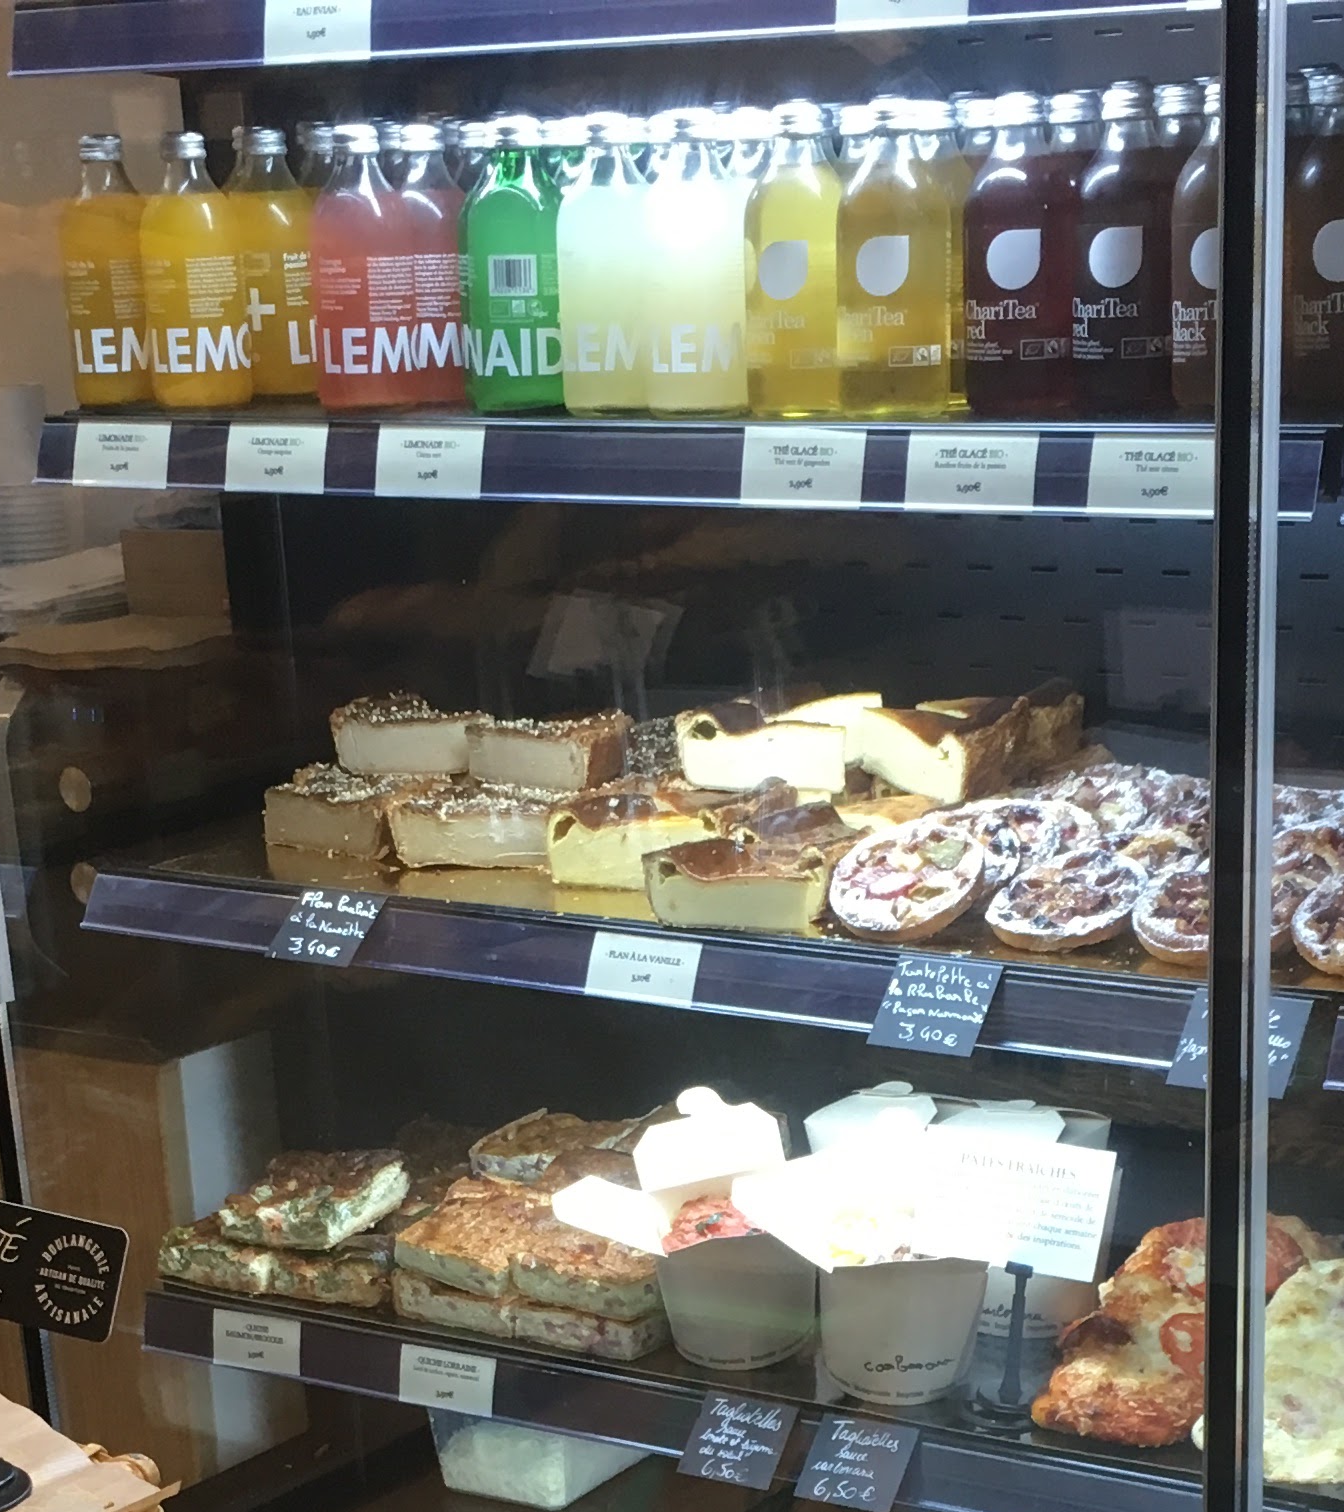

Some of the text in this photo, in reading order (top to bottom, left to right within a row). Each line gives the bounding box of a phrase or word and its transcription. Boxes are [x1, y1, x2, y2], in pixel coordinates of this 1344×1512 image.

[966, 299, 1037, 321] ChariTea
[1072, 297, 1139, 319] ChariTea
[967, 320, 986, 340] red
[1173, 320, 1206, 342] black
[790, 445, 817, 457] GLACÉ
[958, 447, 988, 459] GLACÉ
[1144, 450, 1175, 462] GLACÉ
[42, 1234, 110, 1274] BOULANGERIE
[35, 1284, 104, 1324] ARTISANALE
